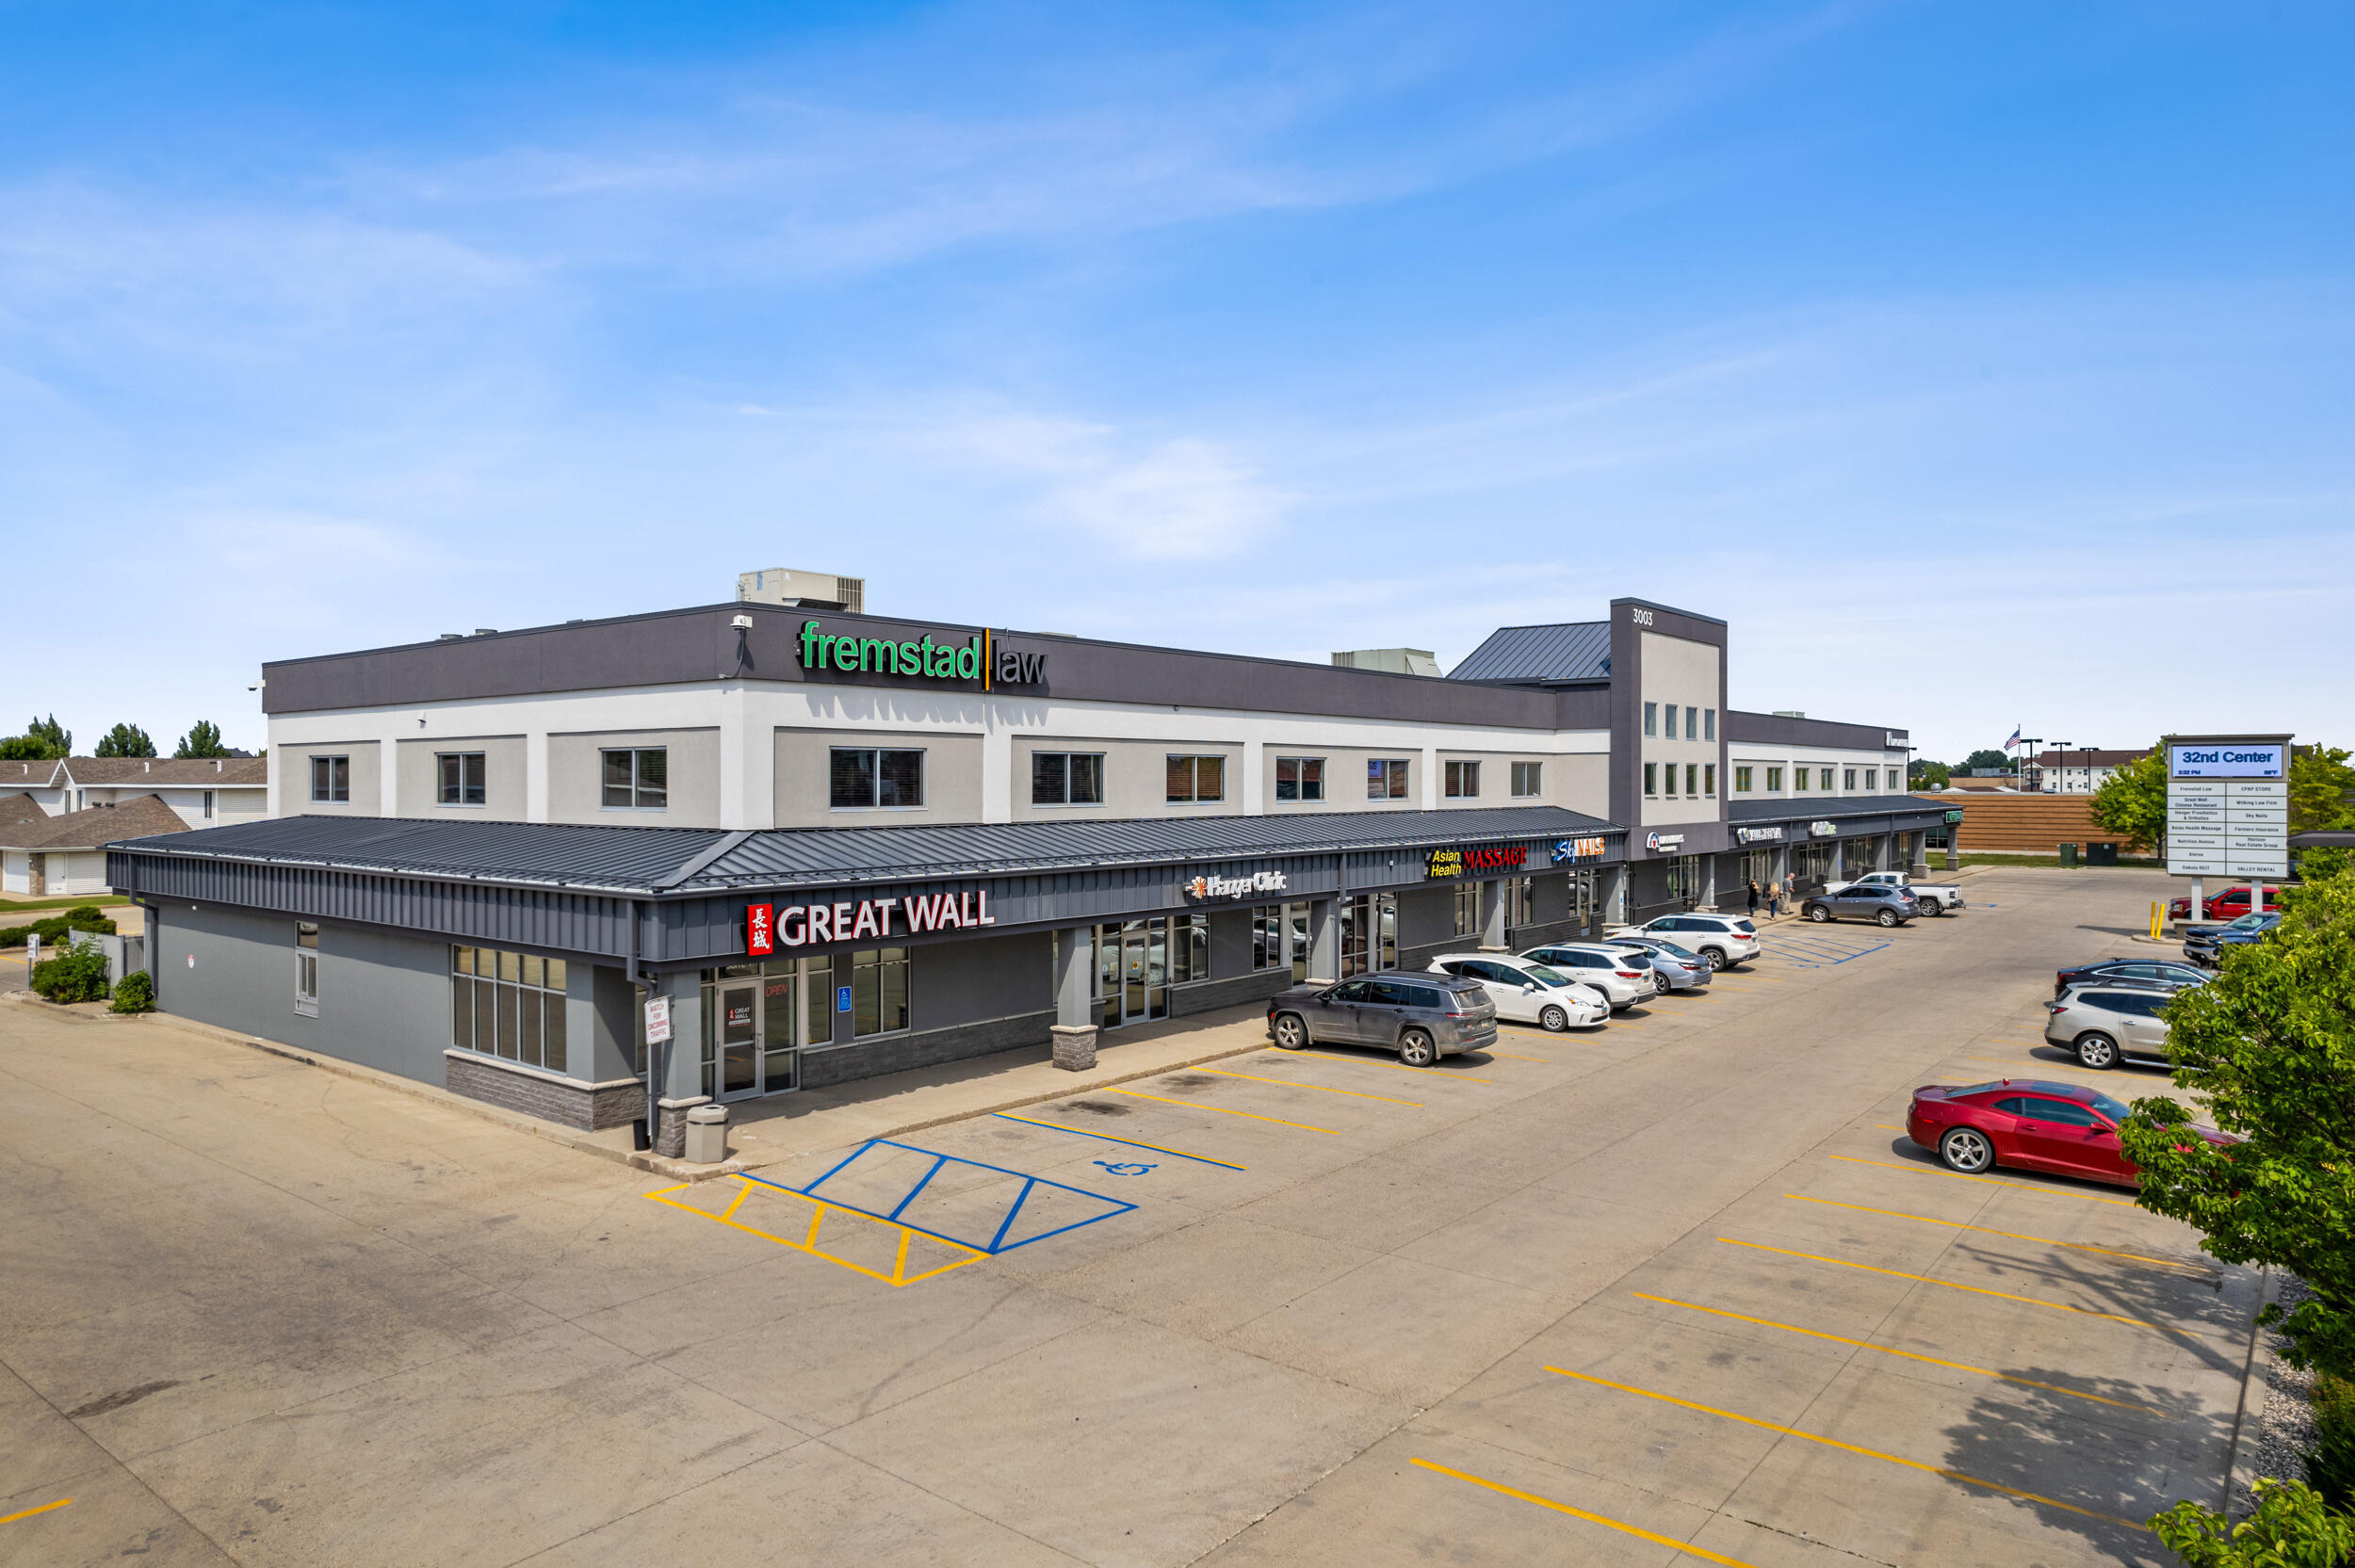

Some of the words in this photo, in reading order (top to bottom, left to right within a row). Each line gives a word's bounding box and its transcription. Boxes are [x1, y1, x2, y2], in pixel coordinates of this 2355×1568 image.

[1633, 607, 1652, 626] 3003
[801, 621, 980, 679] fremstad
[996, 639, 1048, 685] law
[2182, 751, 2219, 763] 32nd
[2222, 751, 2273, 763] Center
[1432, 849, 1460, 864] Asian
[1463, 847, 1528, 869] MASSAGE
[1553, 840, 1576, 864] Sky
[1575, 837, 1605, 857] NAILS
[1431, 863, 1462, 878] Health
[1207, 874, 1255, 899] Hanger
[1253, 870, 1287, 892] Clinic
[752, 907, 771, 949] 長城
[776, 898, 897, 946] GREAT
[903, 890, 995, 932] WALL
[765, 984, 788, 998] OPEN
